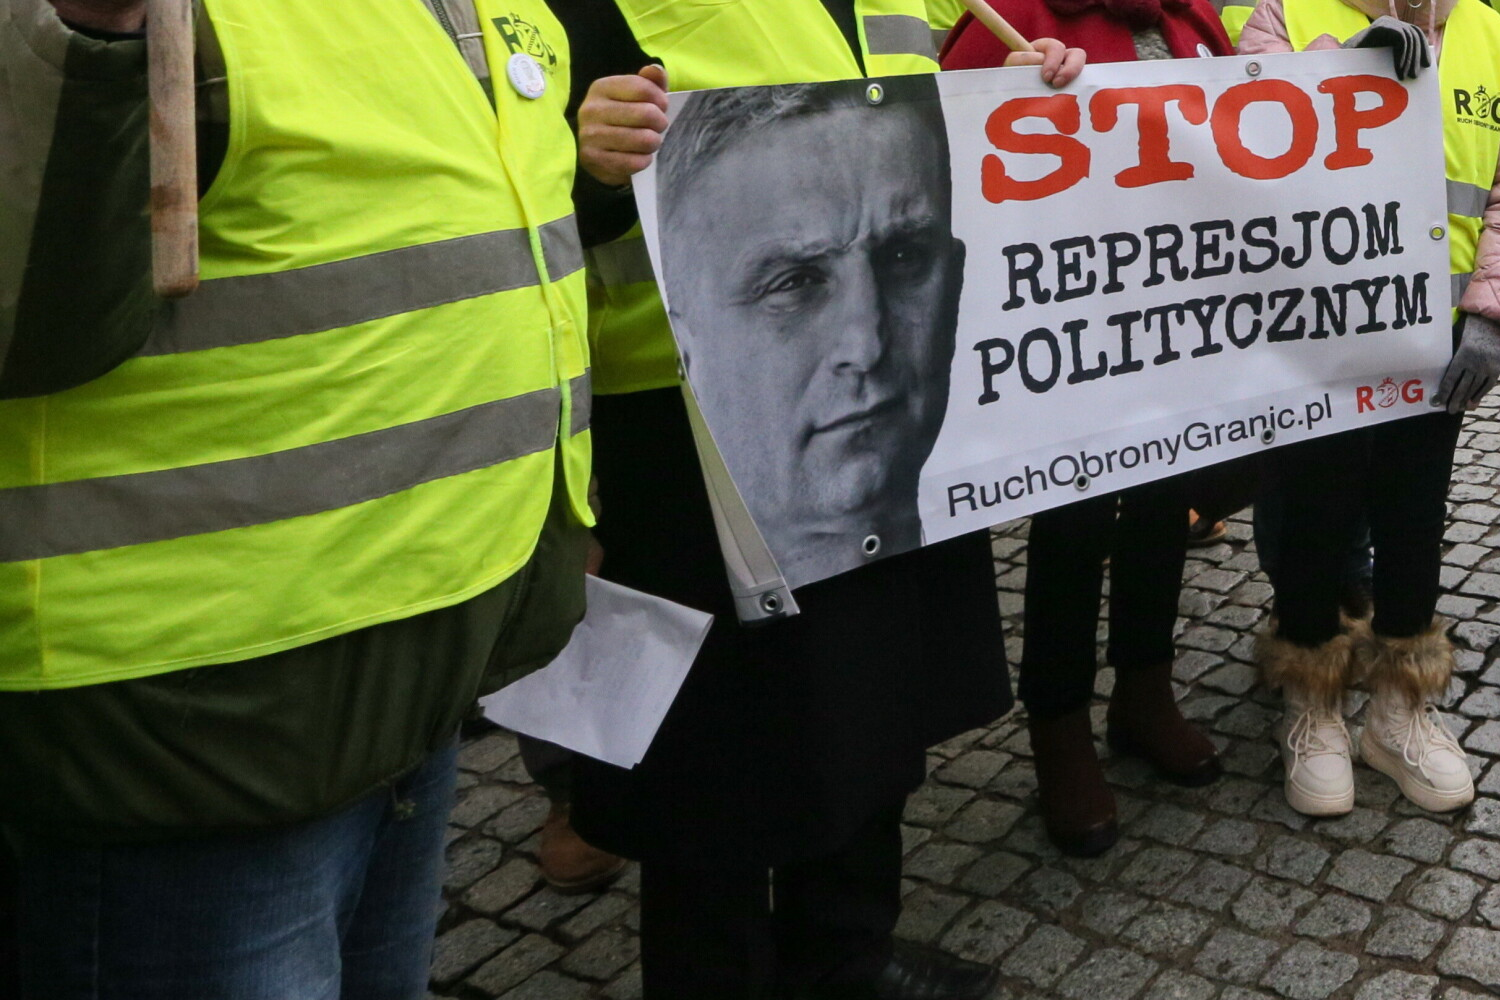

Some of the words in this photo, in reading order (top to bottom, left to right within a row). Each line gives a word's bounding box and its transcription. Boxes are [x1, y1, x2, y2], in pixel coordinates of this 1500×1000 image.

[981, 74, 1410, 204] STOP
[1001, 201, 1405, 312] REPRESJOM
[973, 271, 1433, 406] POLITYCZNYM
[947, 393, 1333, 518] RuchObronyGranic.pl
